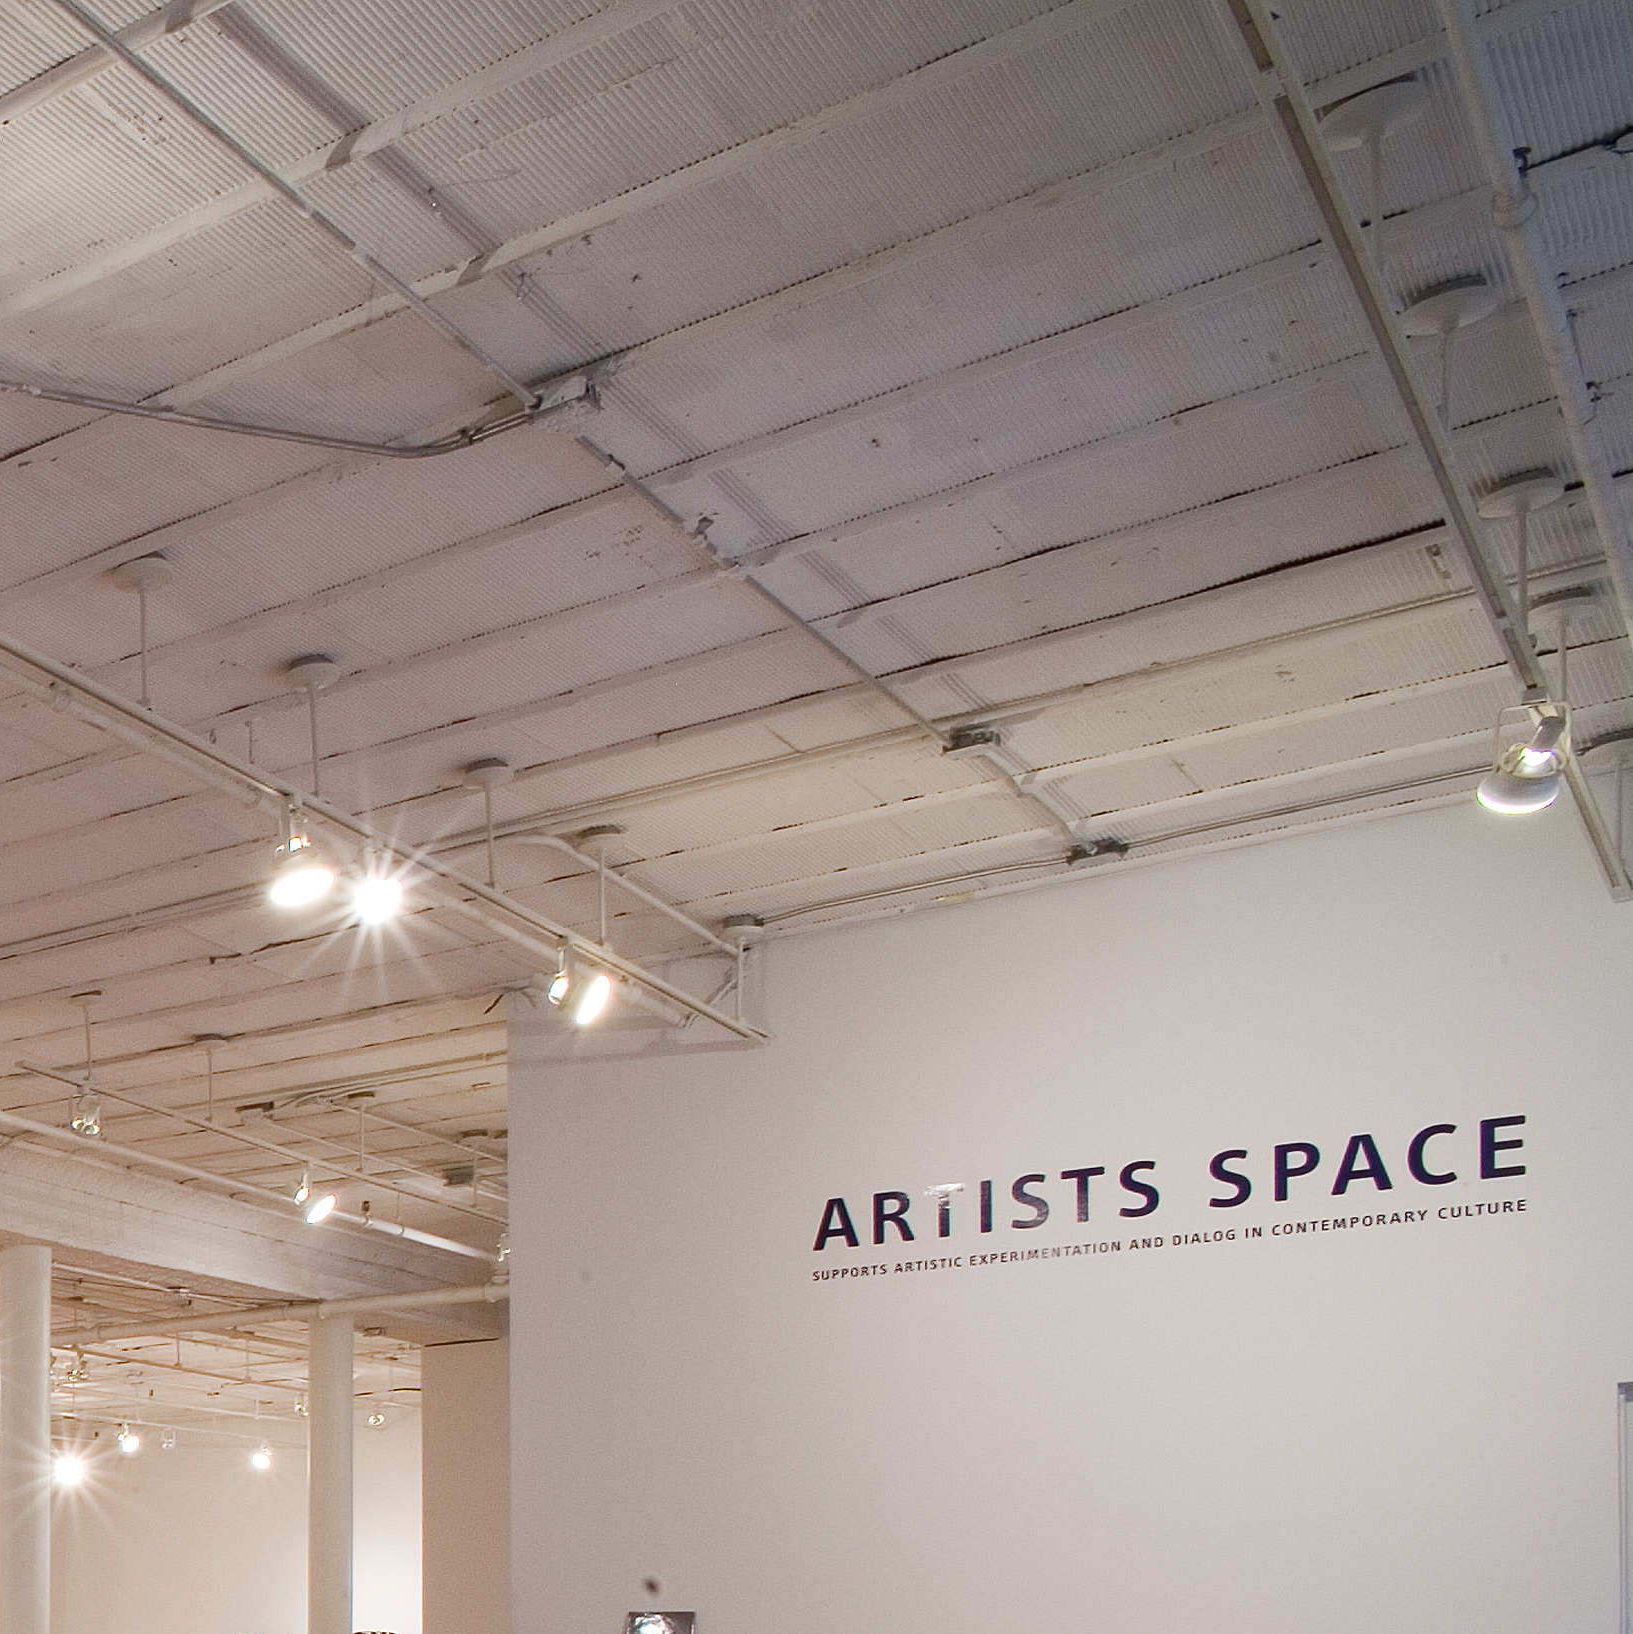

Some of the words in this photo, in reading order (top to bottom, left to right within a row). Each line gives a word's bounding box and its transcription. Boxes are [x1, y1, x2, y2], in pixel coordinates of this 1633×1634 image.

[812, 1160, 1161, 1252] ARTISTS
[1208, 1114, 1528, 1209] SPACE
[812, 1263, 888, 1282] SUPPORTS
[893, 1256, 963, 1274] ARTISTIC
[969, 1240, 1122, 1267] EXPERIMENTATION
[1128, 1236, 1164, 1251] AND
[1172, 1228, 1236, 1247] DIALOG
[1243, 1226, 1263, 1239] IN
[1271, 1205, 1429, 1237] CONTEMPORARY
[1437, 1198, 1527, 1220] CULTURE
